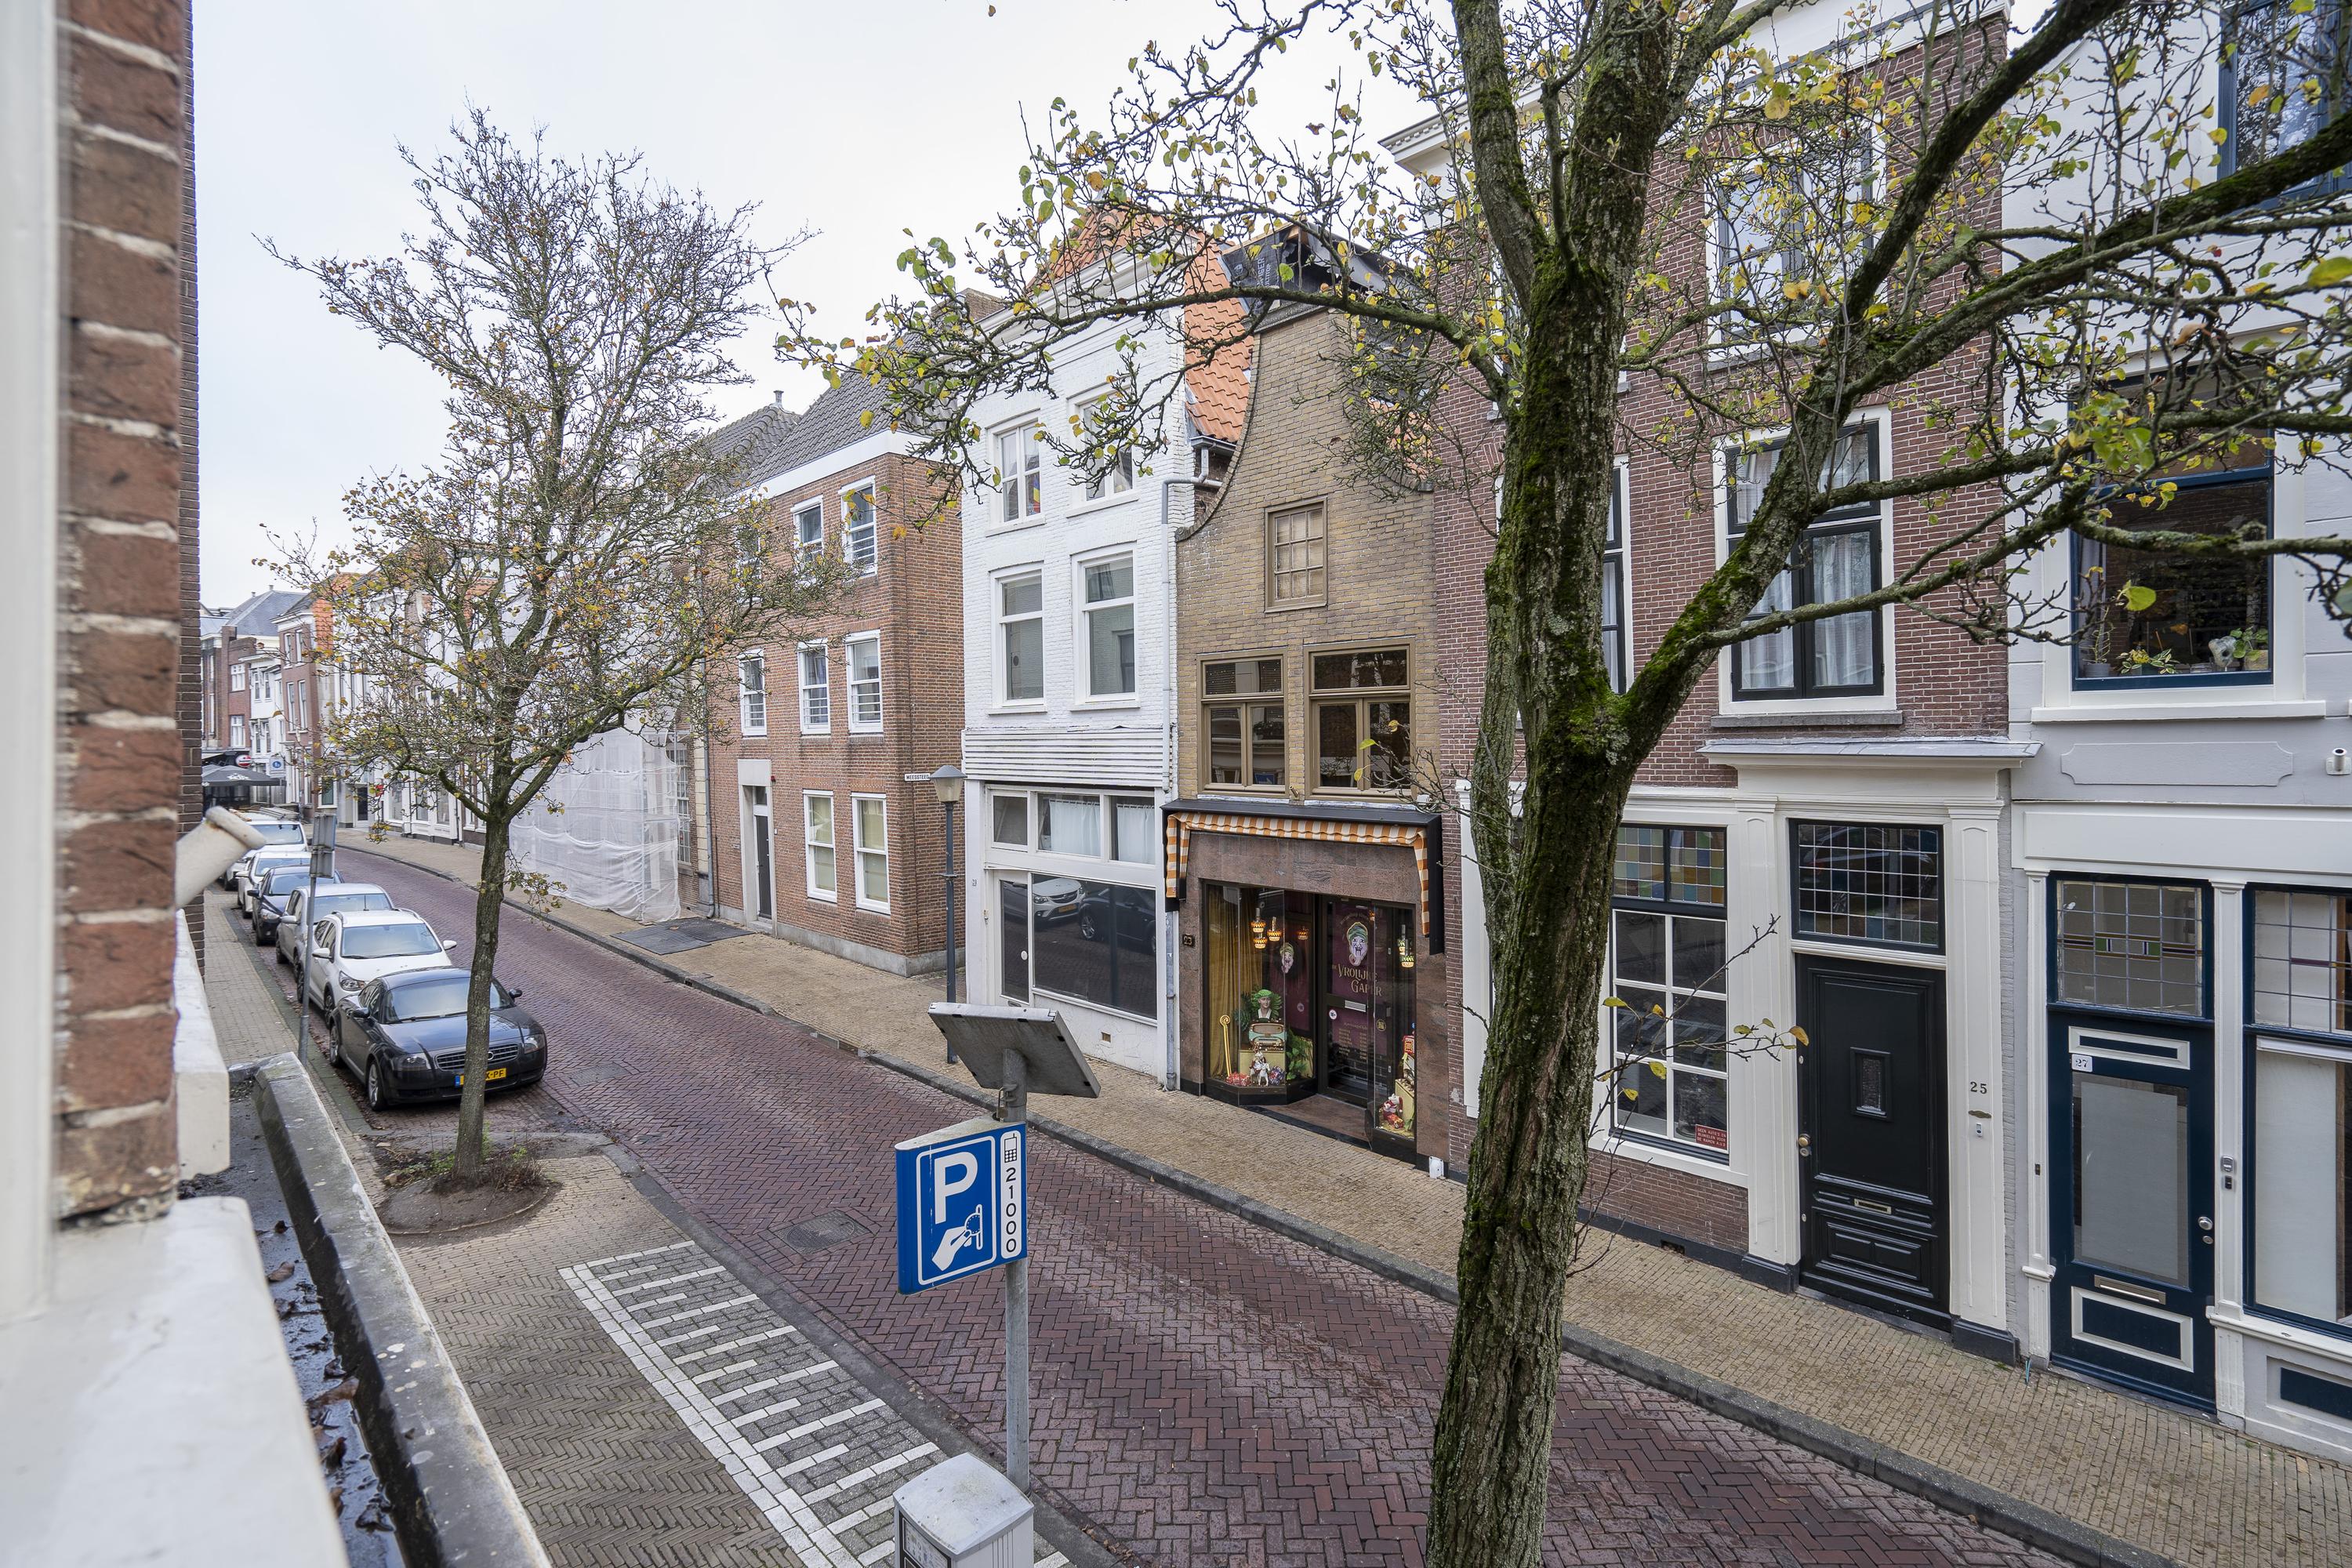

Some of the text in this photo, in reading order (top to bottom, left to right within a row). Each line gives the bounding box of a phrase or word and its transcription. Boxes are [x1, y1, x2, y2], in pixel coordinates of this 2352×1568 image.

[1183, 935, 1192, 946] 23
[2075, 1058, 2089, 1068] 27
[1970, 1081, 1987, 1094] 25
[934, 1152, 978, 1225] P
[1005, 1167, 1017, 1253] 21000
